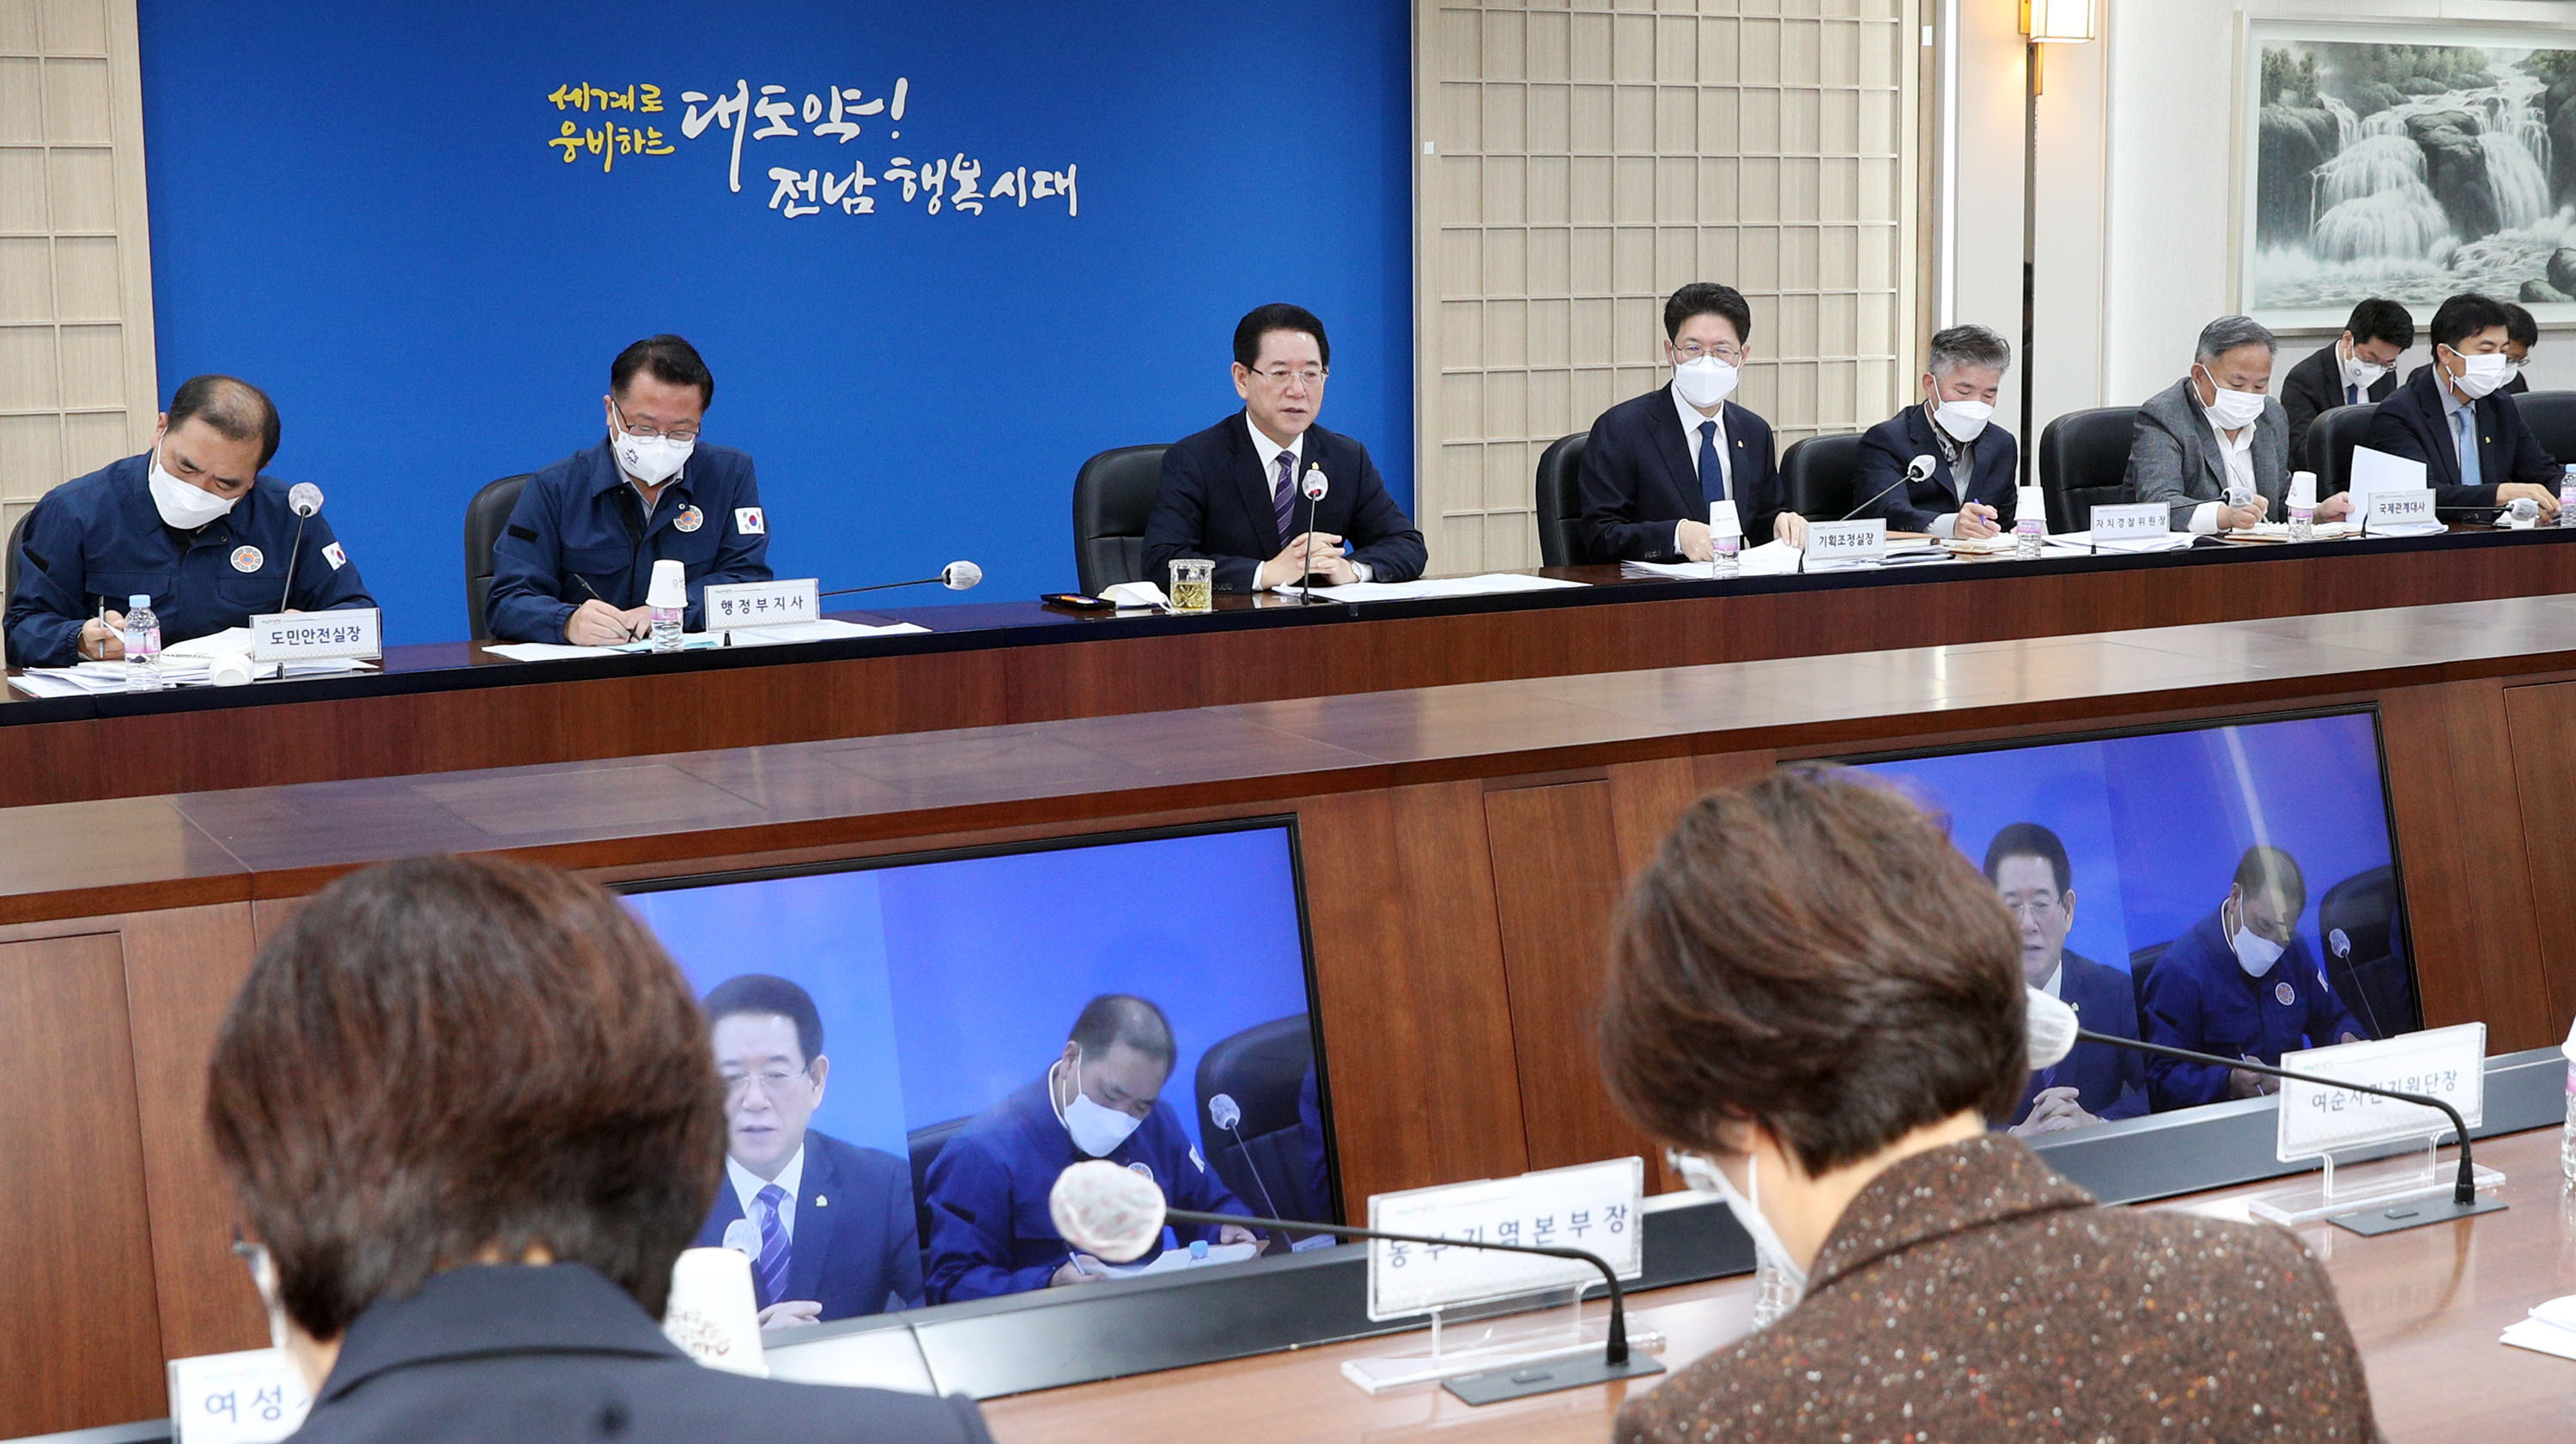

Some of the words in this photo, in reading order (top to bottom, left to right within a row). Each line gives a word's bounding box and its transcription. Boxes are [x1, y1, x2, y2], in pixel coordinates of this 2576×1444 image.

[548, 82, 665, 113] 세계로
[681, 77, 908, 192] 대도약!
[548, 121, 676, 173] 웅비하는
[2379, 501, 2426, 515] 국제관계대사
[2095, 515, 2166, 529] 자치경찰위원장
[1819, 531, 1874, 549] 기획조정실장
[720, 595, 805, 616] 행정부지사
[270, 625, 361, 646] 도민안전실장
[205, 1385, 309, 1423] 여성
